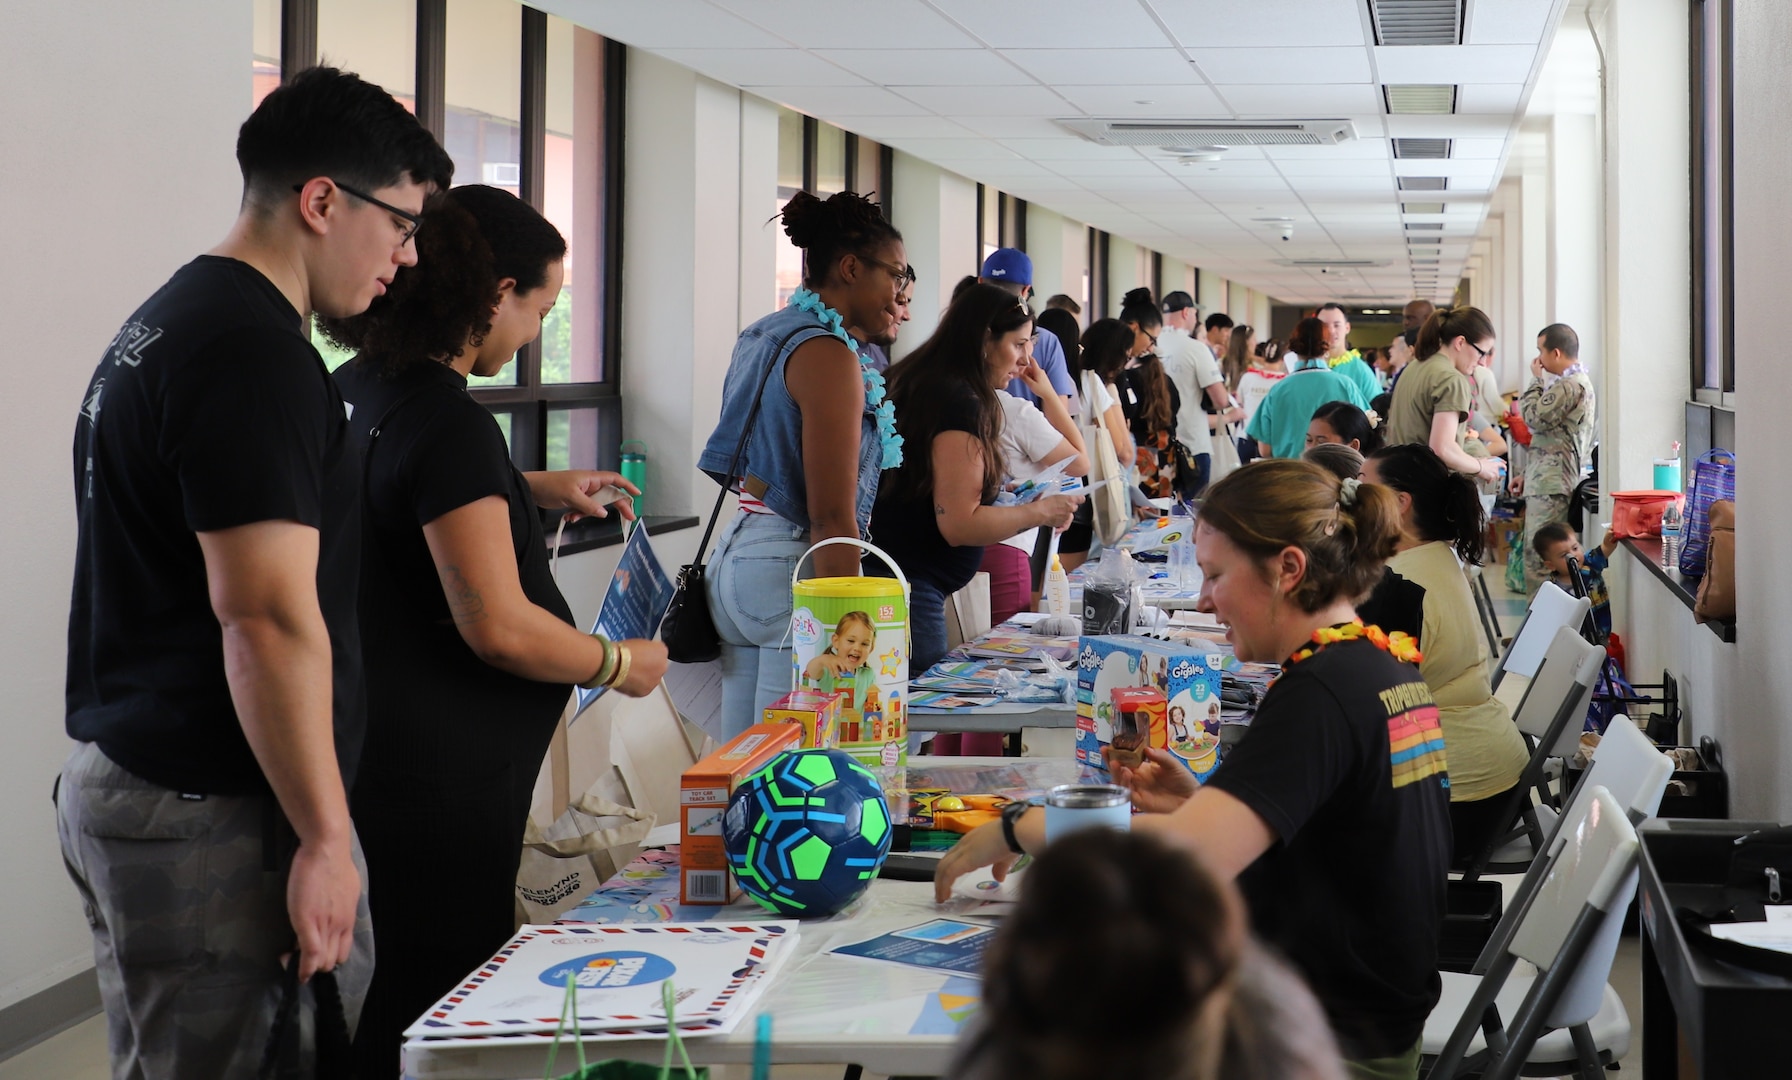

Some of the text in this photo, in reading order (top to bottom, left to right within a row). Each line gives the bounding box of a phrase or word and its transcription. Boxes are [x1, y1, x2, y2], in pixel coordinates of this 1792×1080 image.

[879, 607, 893, 616] 152
[1079, 647, 1105, 672] Giggles
[1172, 662, 1204, 679] Giggles
[1195, 684, 1206, 692] 22
[516, 872, 580, 895] TELEMYND
